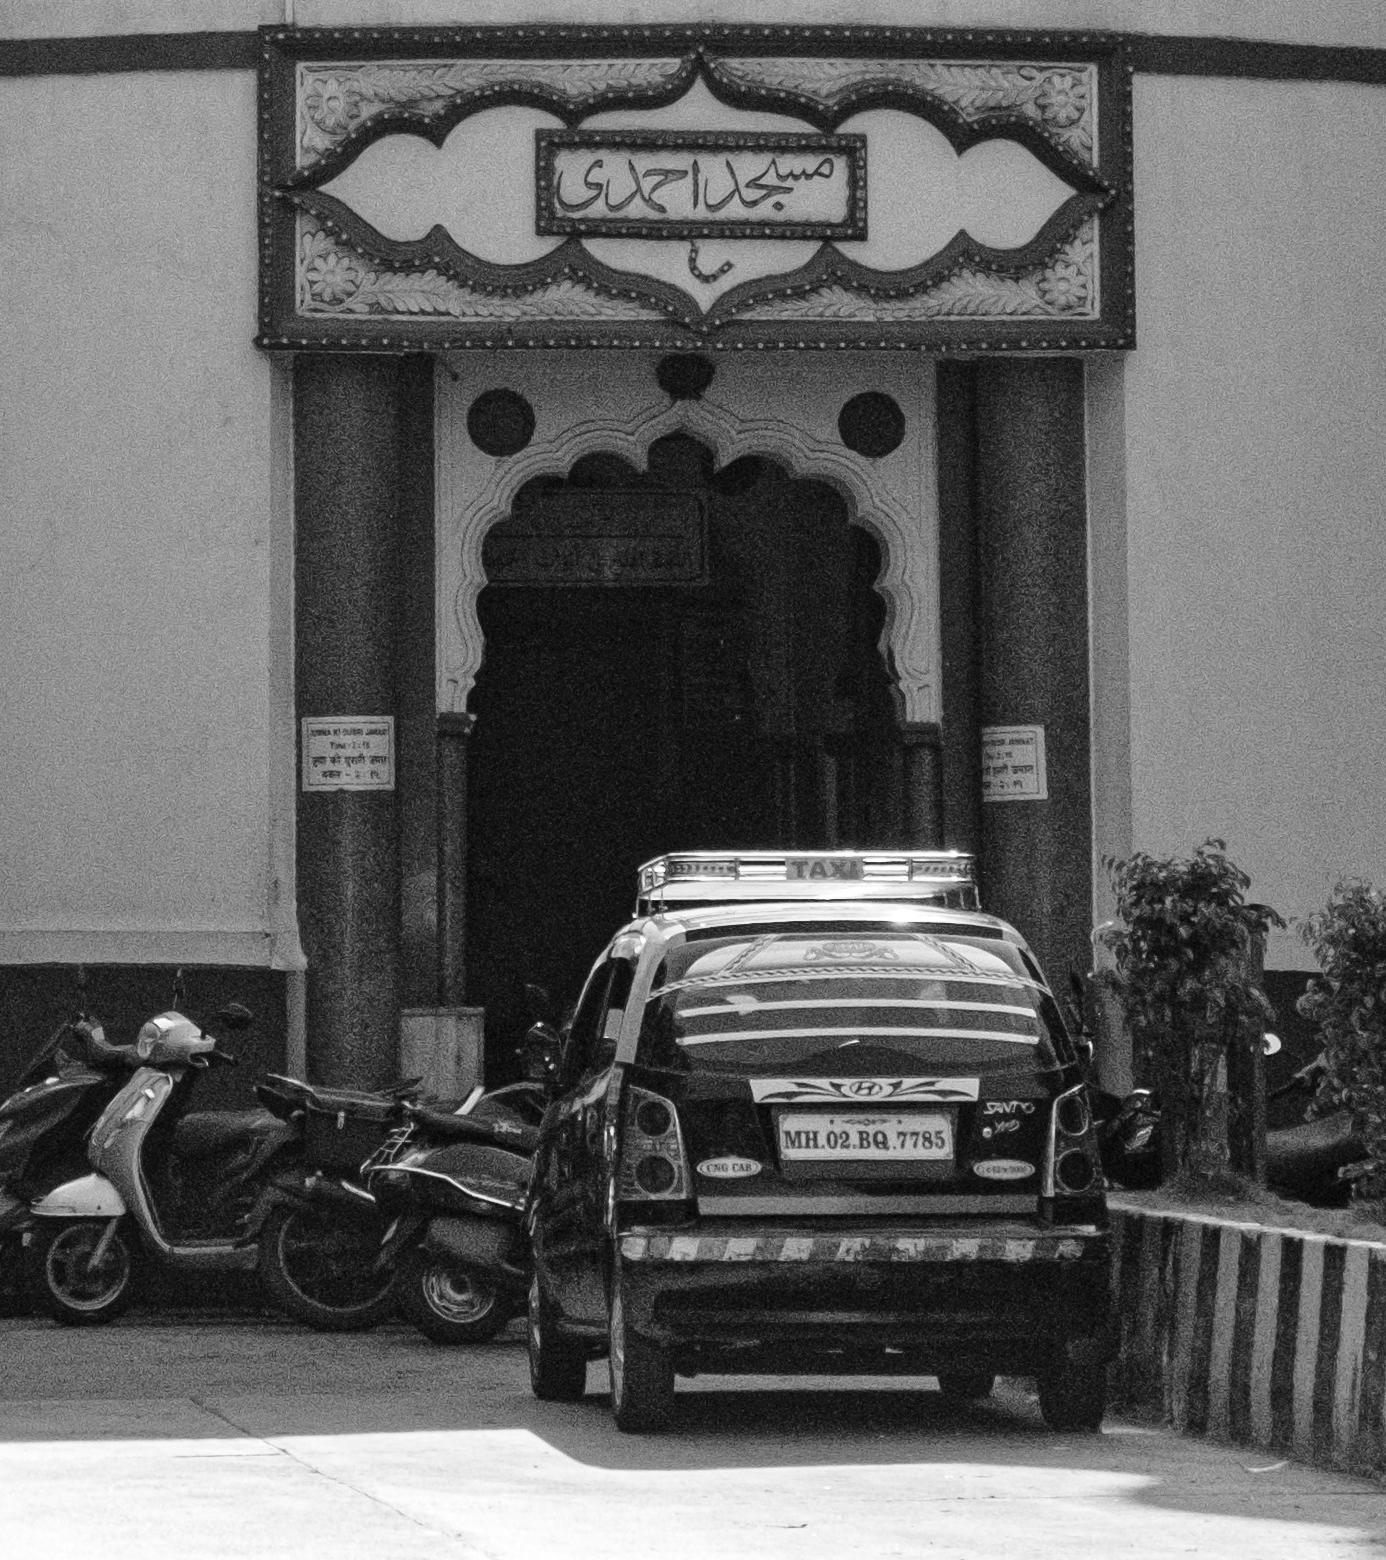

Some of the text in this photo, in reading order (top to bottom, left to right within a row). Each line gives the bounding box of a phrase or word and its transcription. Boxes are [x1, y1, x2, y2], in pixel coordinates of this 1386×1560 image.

[703, 156, 835, 213] مسجد
[789, 860, 861, 880] TAXI
[706, 1162, 753, 1173] CNG CAB
